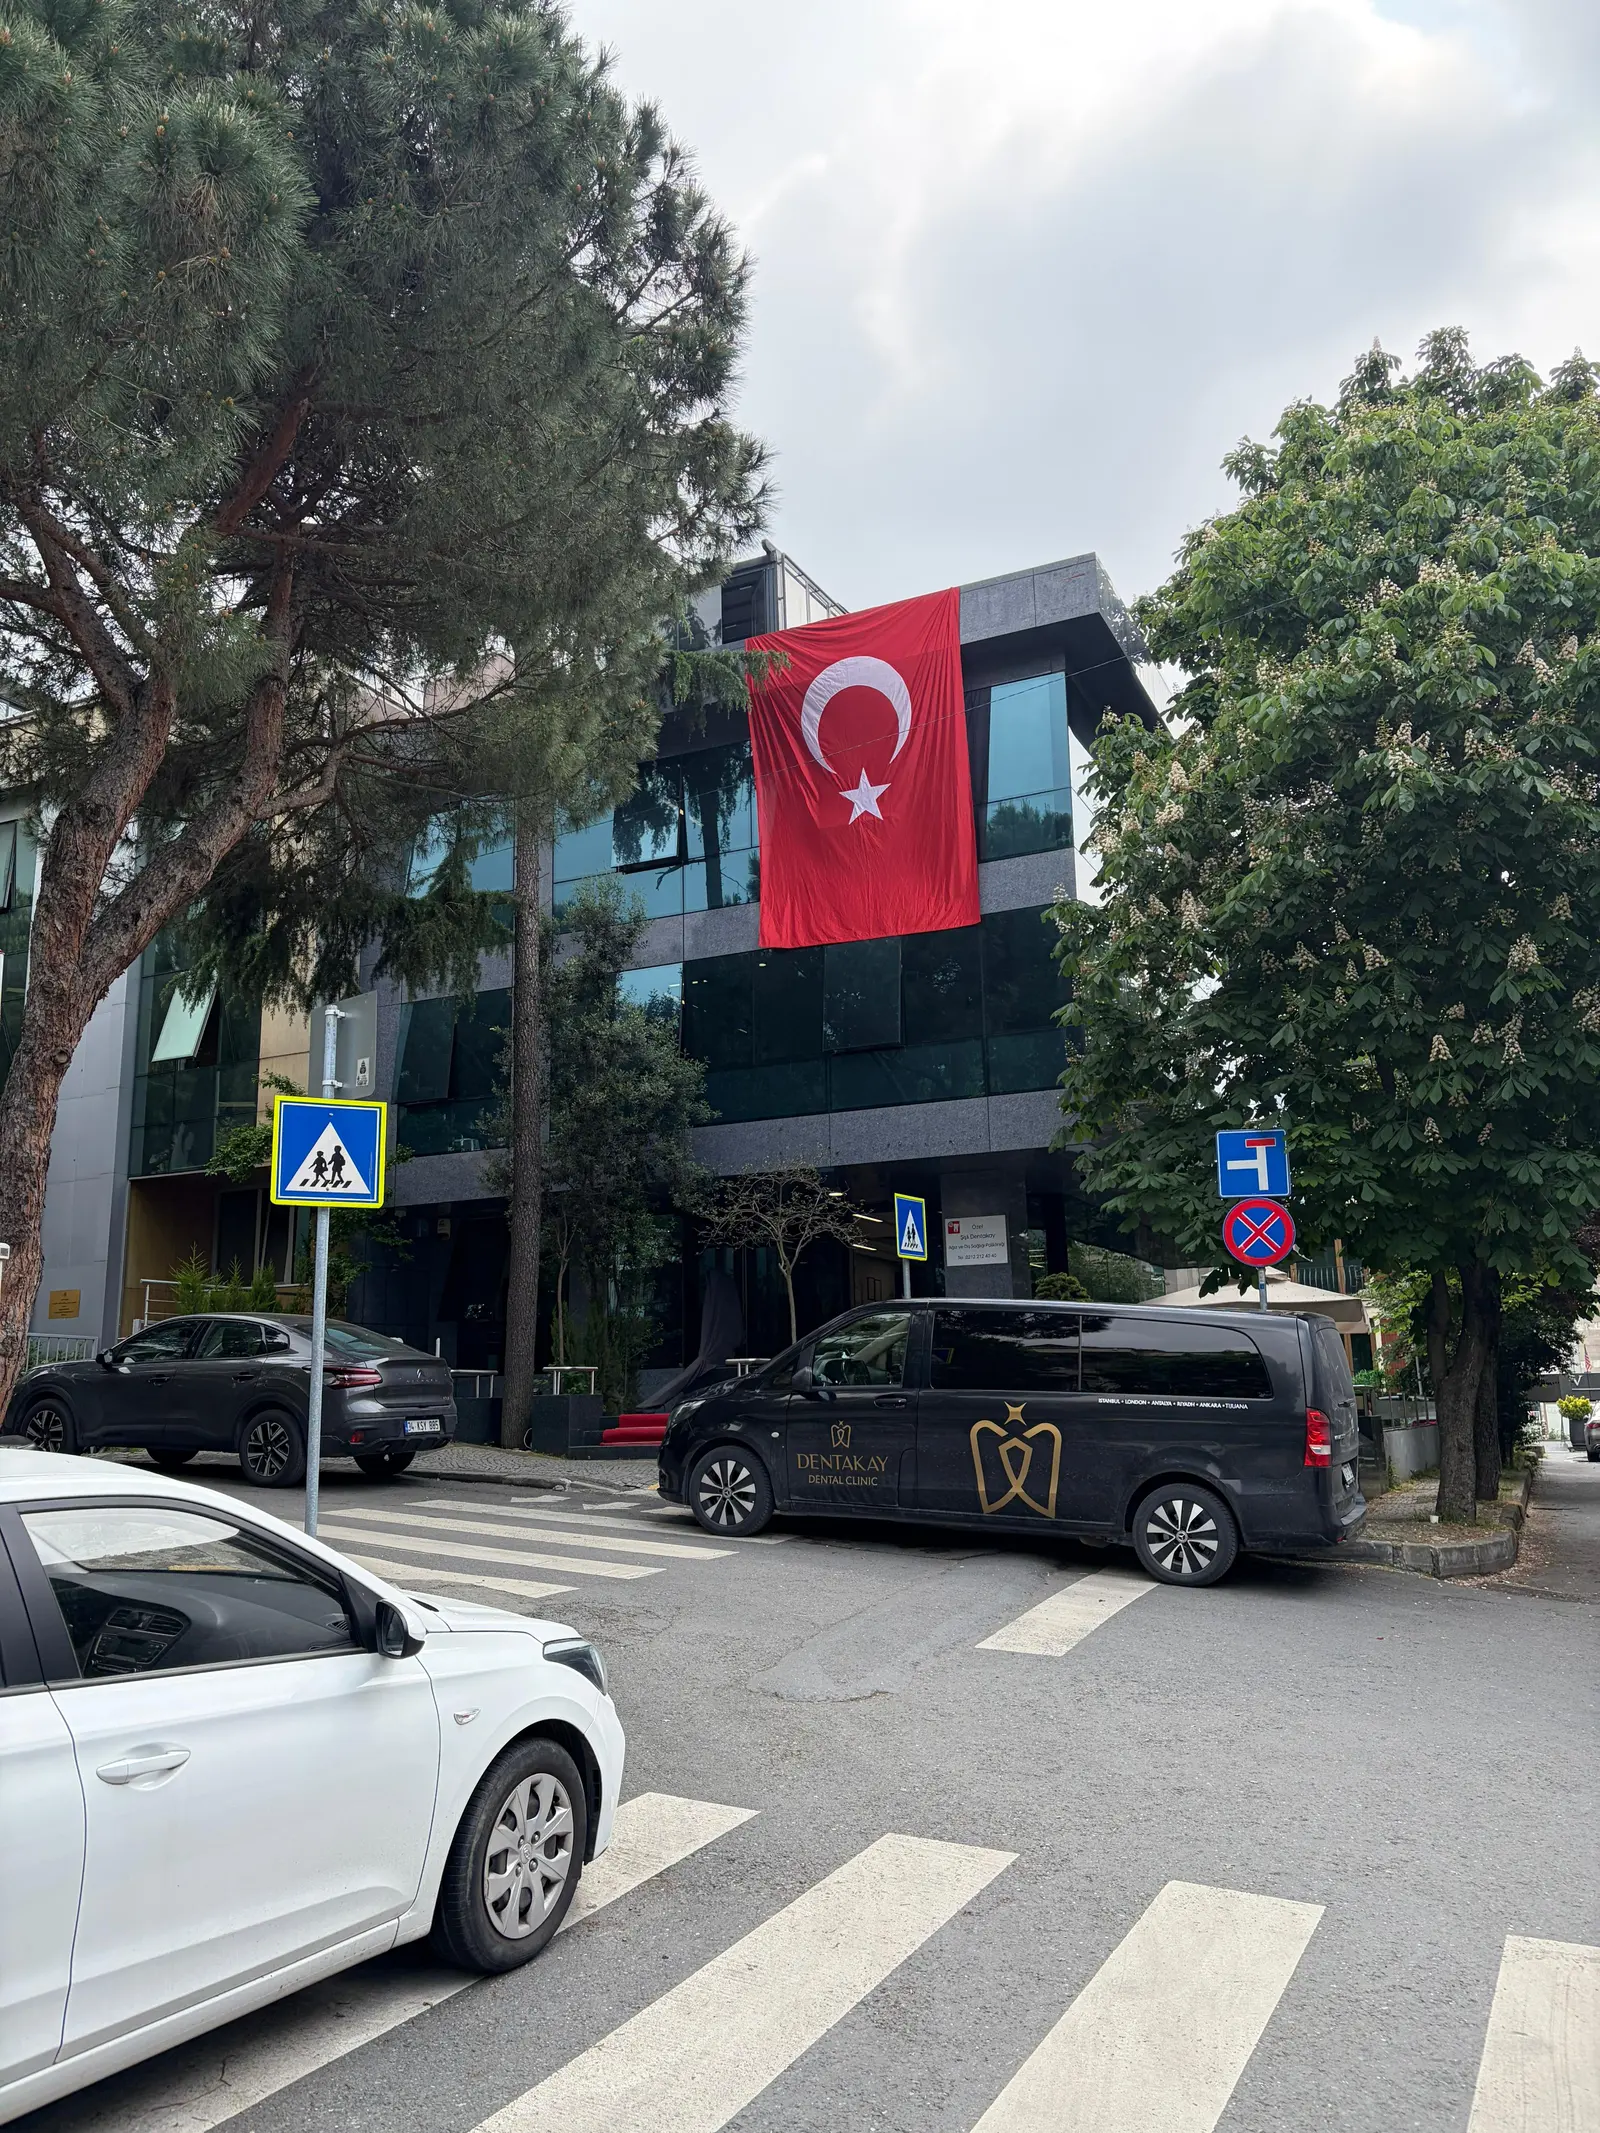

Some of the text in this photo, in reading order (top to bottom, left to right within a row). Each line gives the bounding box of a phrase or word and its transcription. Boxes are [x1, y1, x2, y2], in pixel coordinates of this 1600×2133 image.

[796, 1453, 888, 1472] DENTAKAY
[808, 1474, 878, 1486] DENTAL CLINIC
